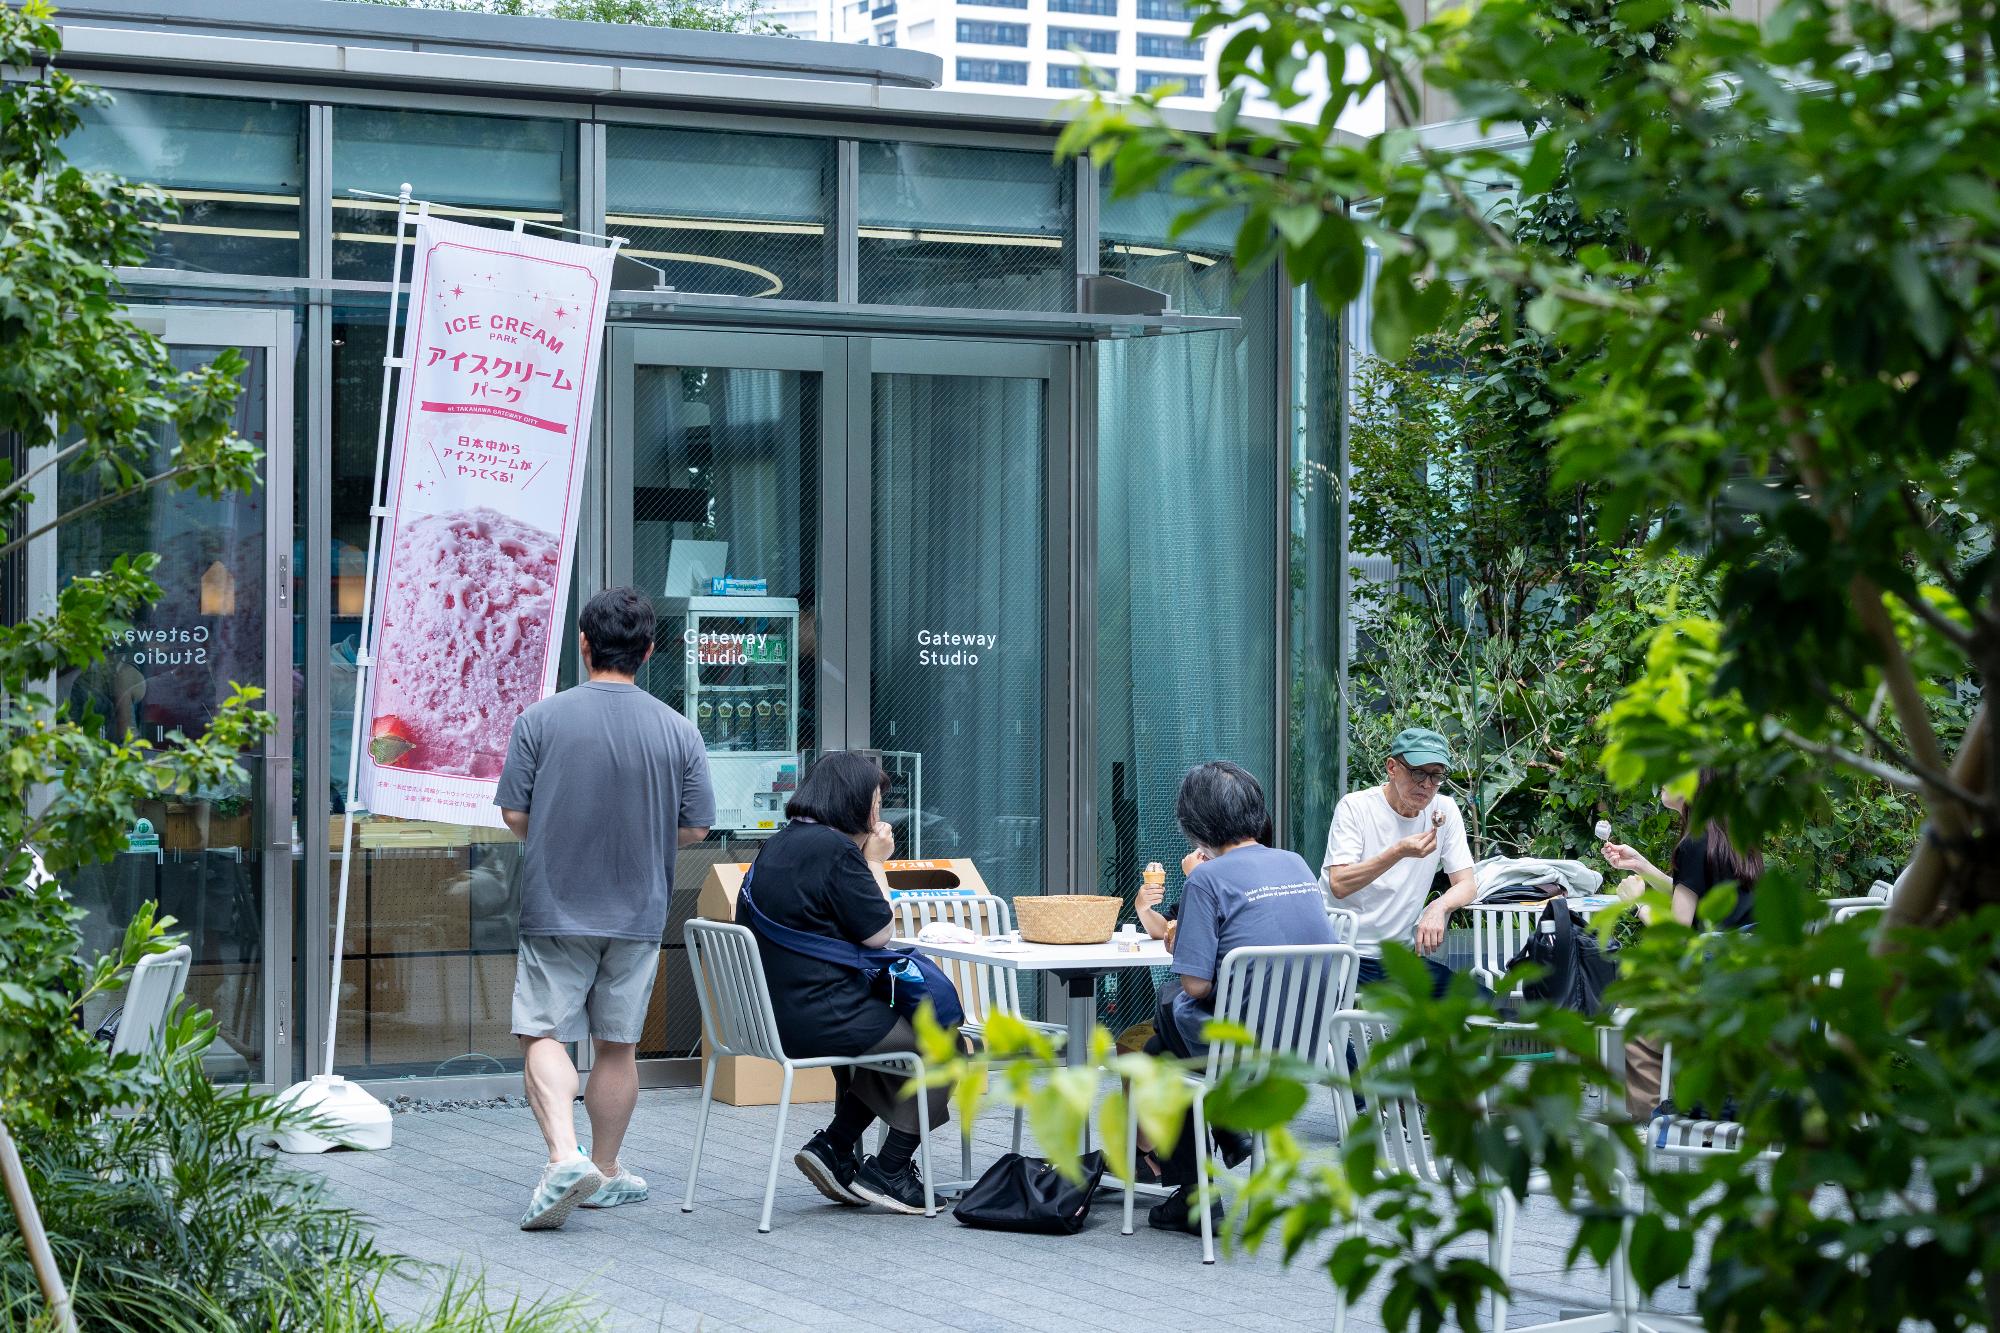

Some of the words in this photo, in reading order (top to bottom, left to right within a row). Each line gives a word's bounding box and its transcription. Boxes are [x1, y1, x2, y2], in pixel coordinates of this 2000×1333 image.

[444, 314, 481, 335] ICE
[490, 314, 565, 355] CREAM
[489, 332, 518, 345] PARK
[427, 346, 573, 391] アイスクリーム
[471, 381, 522, 403] パーク
[456, 406, 492, 414] TAKANAWA
[492, 409, 523, 421] GATEWAY
[523, 416, 539, 425] CITY
[457, 435, 521, 455] 日本中から
[443, 447, 533, 472] アイスクリームが
[713, 579, 725, 591] M
[683, 628, 768, 649] Gateway
[917, 629, 997, 650] Gateway
[685, 649, 748, 666] Studio
[919, 650, 979, 665] Studio
